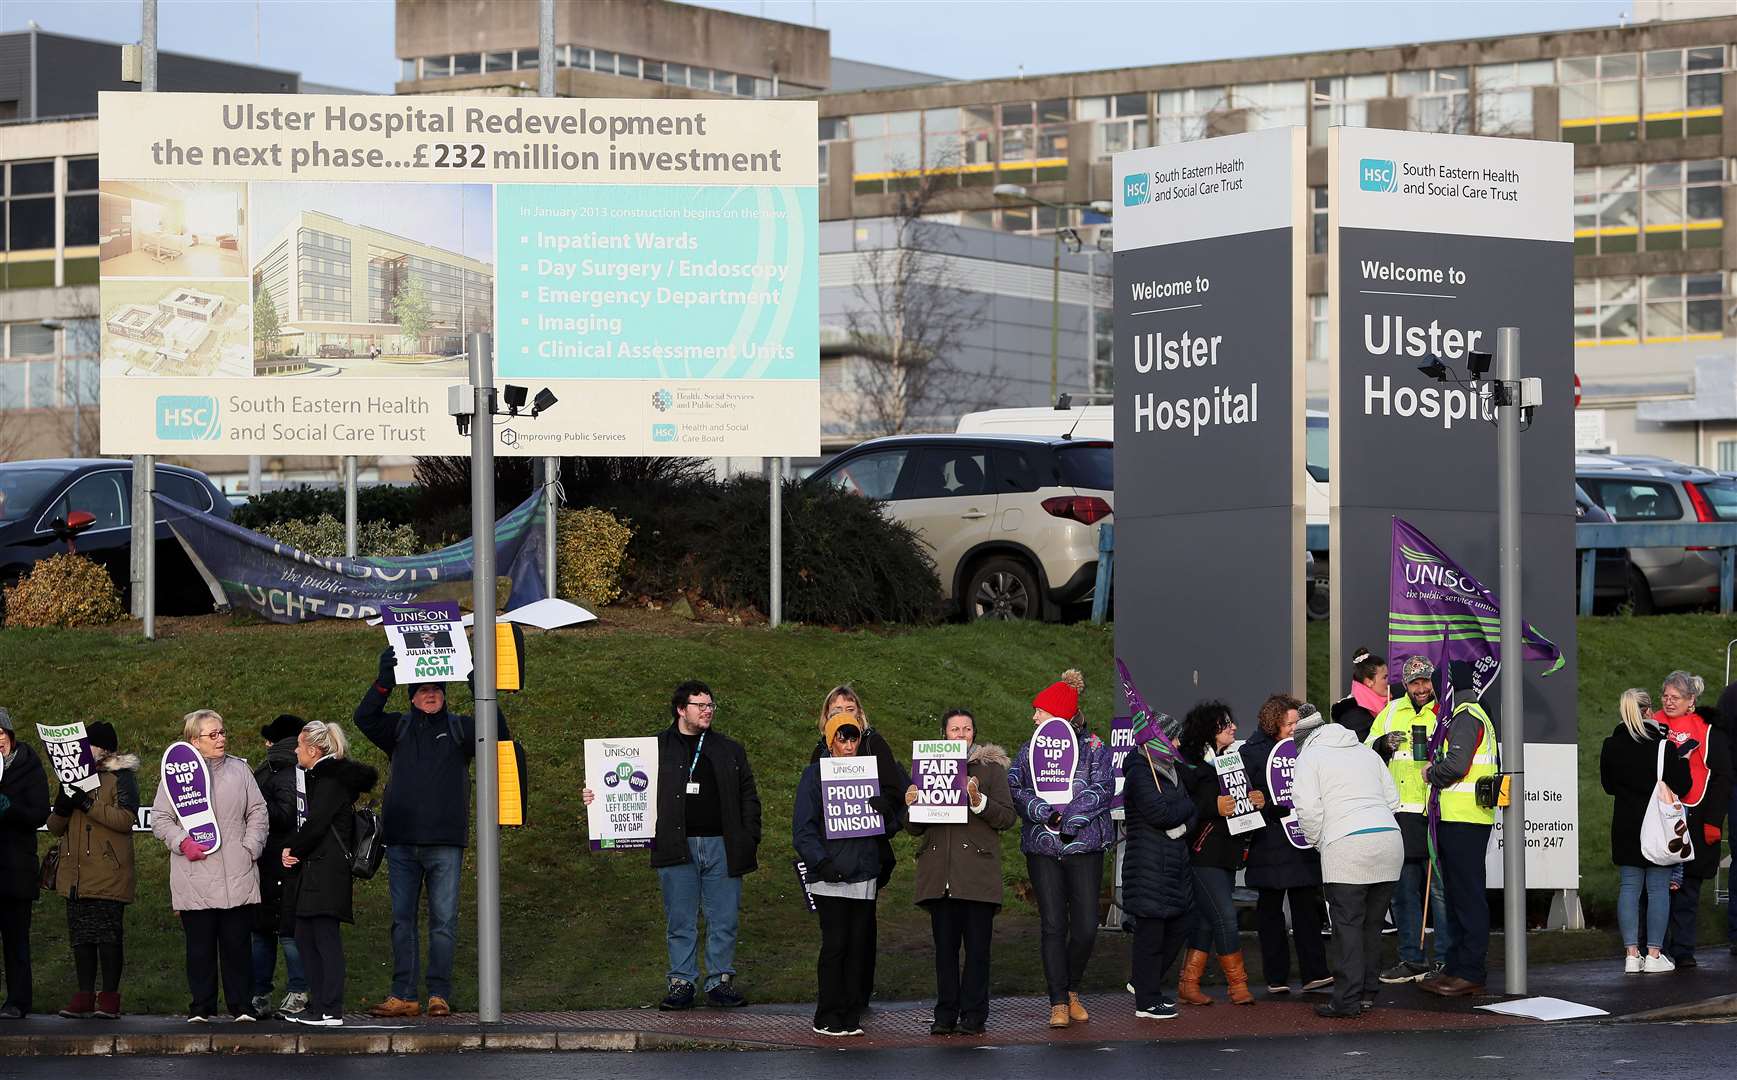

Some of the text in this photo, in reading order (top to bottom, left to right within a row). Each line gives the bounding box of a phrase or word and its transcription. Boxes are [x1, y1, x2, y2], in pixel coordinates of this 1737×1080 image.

[222, 104, 707, 141] Ulster Hospital Redevelopment
[151, 139, 203, 166] the
[213, 142, 282, 167] next
[493, 143, 599, 170] million
[609, 145, 782, 172] investment
[1155, 159, 1244, 184] South Eastern Health
[1364, 168, 1390, 182] HSC
[1403, 162, 1520, 184] South Eastern Health
[1127, 182, 1146, 197] HSC
[1155, 178, 1243, 201] and Social Care Trust
[1403, 182, 1518, 201] and Social Care Trust
[520, 207, 531, 217] In
[533, 207, 577, 219] January
[579, 207, 608, 218] 2013
[610, 208, 681, 219] construction
[683, 208, 720, 220] begins
[722, 210, 739, 219] on
[740, 208, 759, 219] the
[537, 232, 698, 252] Inpatient Wards
[537, 259, 789, 281] Day Surgery / Endoscopy
[1361, 260, 1466, 284] Welcome to
[1132, 275, 1210, 301] Welcome to
[538, 286, 780, 308] Emergency Department
[538, 314, 623, 334] Imaging
[1364, 314, 1483, 359] Ulster
[538, 341, 795, 360] Clinical Assessment Units
[1134, 331, 1222, 373] Ulster
[704, 392, 725, 401] Social
[230, 396, 429, 414] South Eastern Health
[1135, 383, 1257, 437] Hospital
[164, 408, 208, 426] HSC
[230, 424, 426, 441] and Social Care Trust
[518, 432, 626, 442] Improving Public Services
[281, 568, 301, 582] the
[301, 575, 347, 594] public
[1406, 589, 1418, 599] the
[1419, 590, 1443, 601] public
[1445, 594, 1474, 606] service
[394, 610, 448, 622] UNISON
[400, 624, 449, 632] UNISON
[416, 655, 451, 666] ACT
[415, 666, 454, 677] NOW!
[41, 726, 80, 737] UNISON
[46, 741, 83, 756] FAIR
[919, 743, 961, 753] UNISON
[1036, 736, 1070, 750] Step
[604, 747, 640, 758] UNISON
[1044, 748, 1063, 760] up
[52, 753, 81, 770] PAY
[165, 760, 198, 775] Step
[919, 759, 958, 775] FAIR
[1217, 755, 1240, 768] UNISON
[1272, 756, 1296, 769] Ste
[619, 766, 631, 777] UP
[832, 764, 865, 776] UNISON
[175, 772, 194, 784] up
[605, 774, 618, 785] PAY
[630, 776, 647, 788] NOW!
[923, 775, 956, 790] PAY
[1222, 770, 1247, 788] FAIR
[178, 790, 201, 802] public
[606, 792, 647, 802] WE WON'T BE
[827, 785, 875, 801] PROUD
[918, 789, 961, 805] NOW
[1229, 784, 1247, 800] PAY
[1543, 791, 1562, 801] Site
[176, 797, 208, 809] services
[605, 804, 621, 813] LEFT
[827, 803, 841, 817] to
[845, 803, 861, 815] be
[610, 813, 643, 823] CLOSE THE
[828, 815, 881, 832] UNISON
[614, 823, 643, 832] PAY GAP!
[1524, 821, 1574, 833] Operation
[1543, 836, 1564, 848] 24/7
